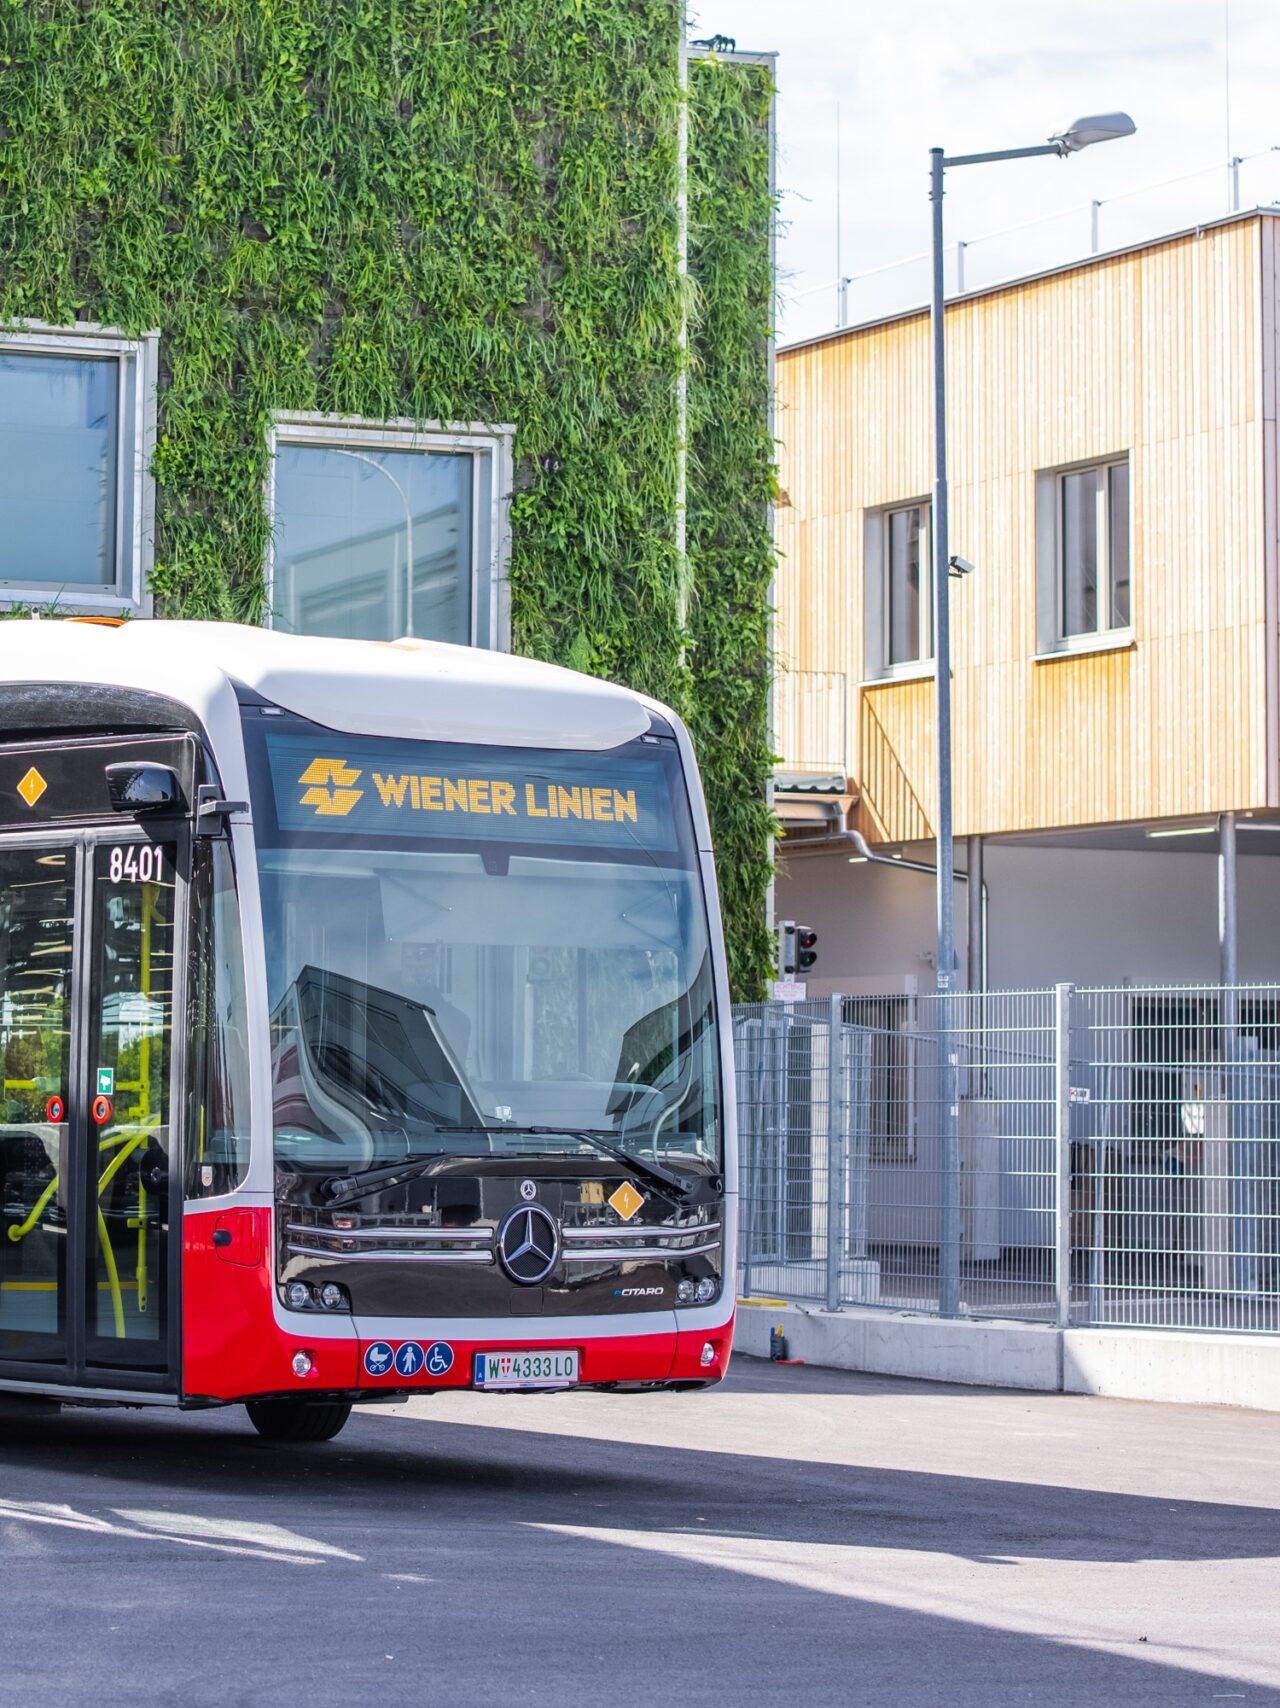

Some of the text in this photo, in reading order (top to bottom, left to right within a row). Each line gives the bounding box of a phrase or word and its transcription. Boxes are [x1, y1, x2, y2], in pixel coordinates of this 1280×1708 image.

[372, 772, 638, 823] WIENER LINIEN
[110, 845, 163, 883] 8401
